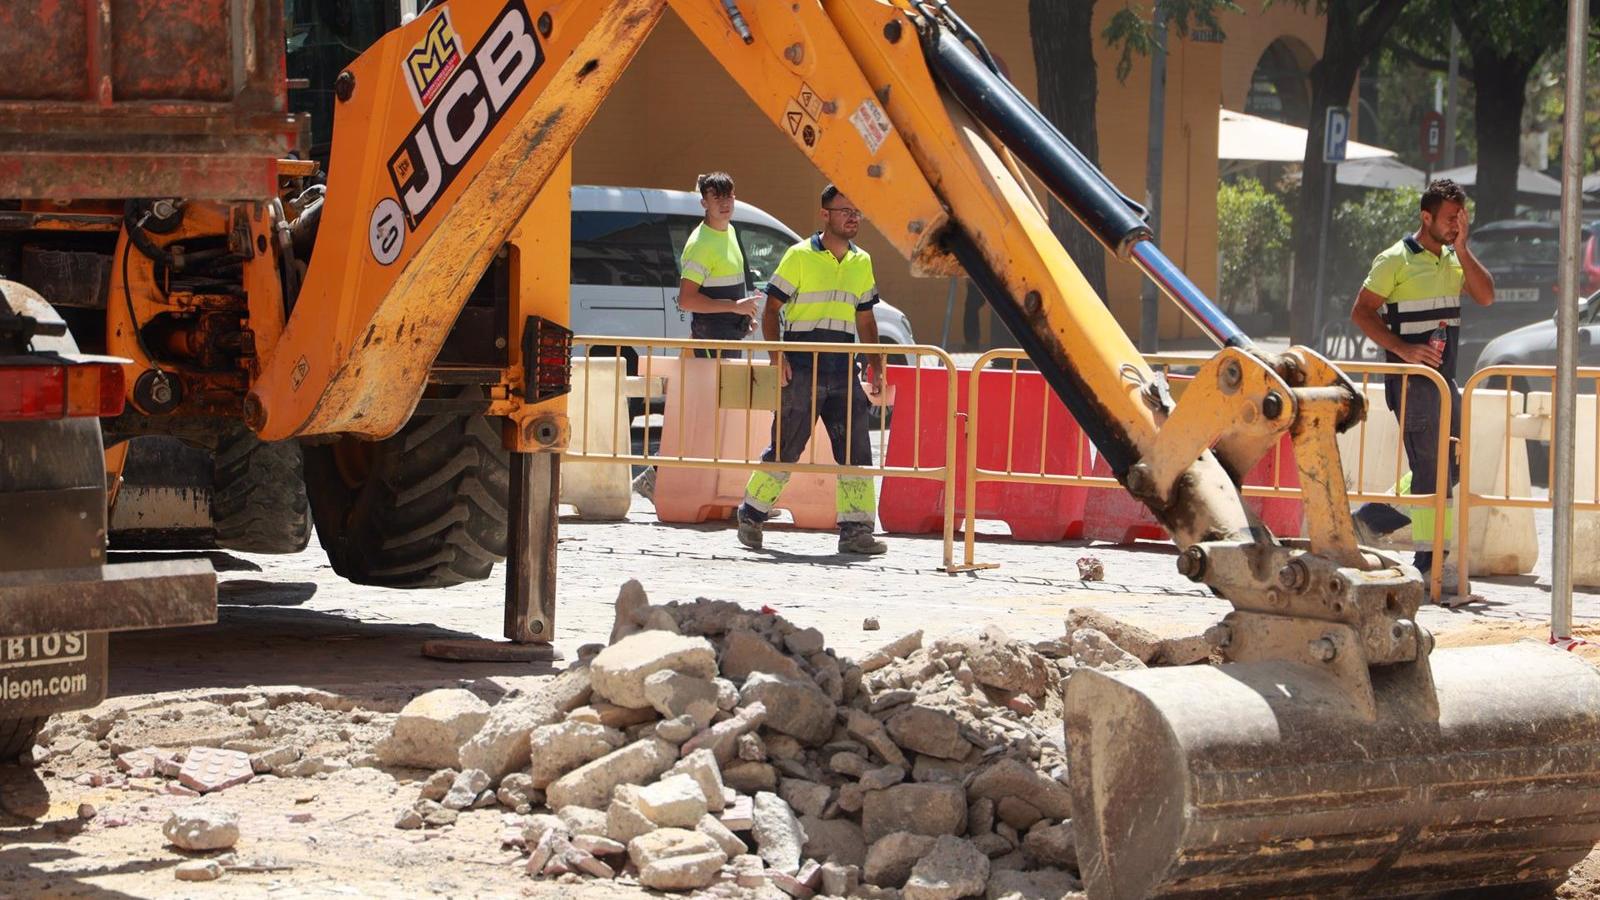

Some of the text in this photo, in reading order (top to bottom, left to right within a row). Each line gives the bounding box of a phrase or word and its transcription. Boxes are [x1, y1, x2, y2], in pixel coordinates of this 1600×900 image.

[403, 9, 536, 216] JCB
[1329, 113, 1346, 157] P
[0, 631, 81, 660] BIOS
